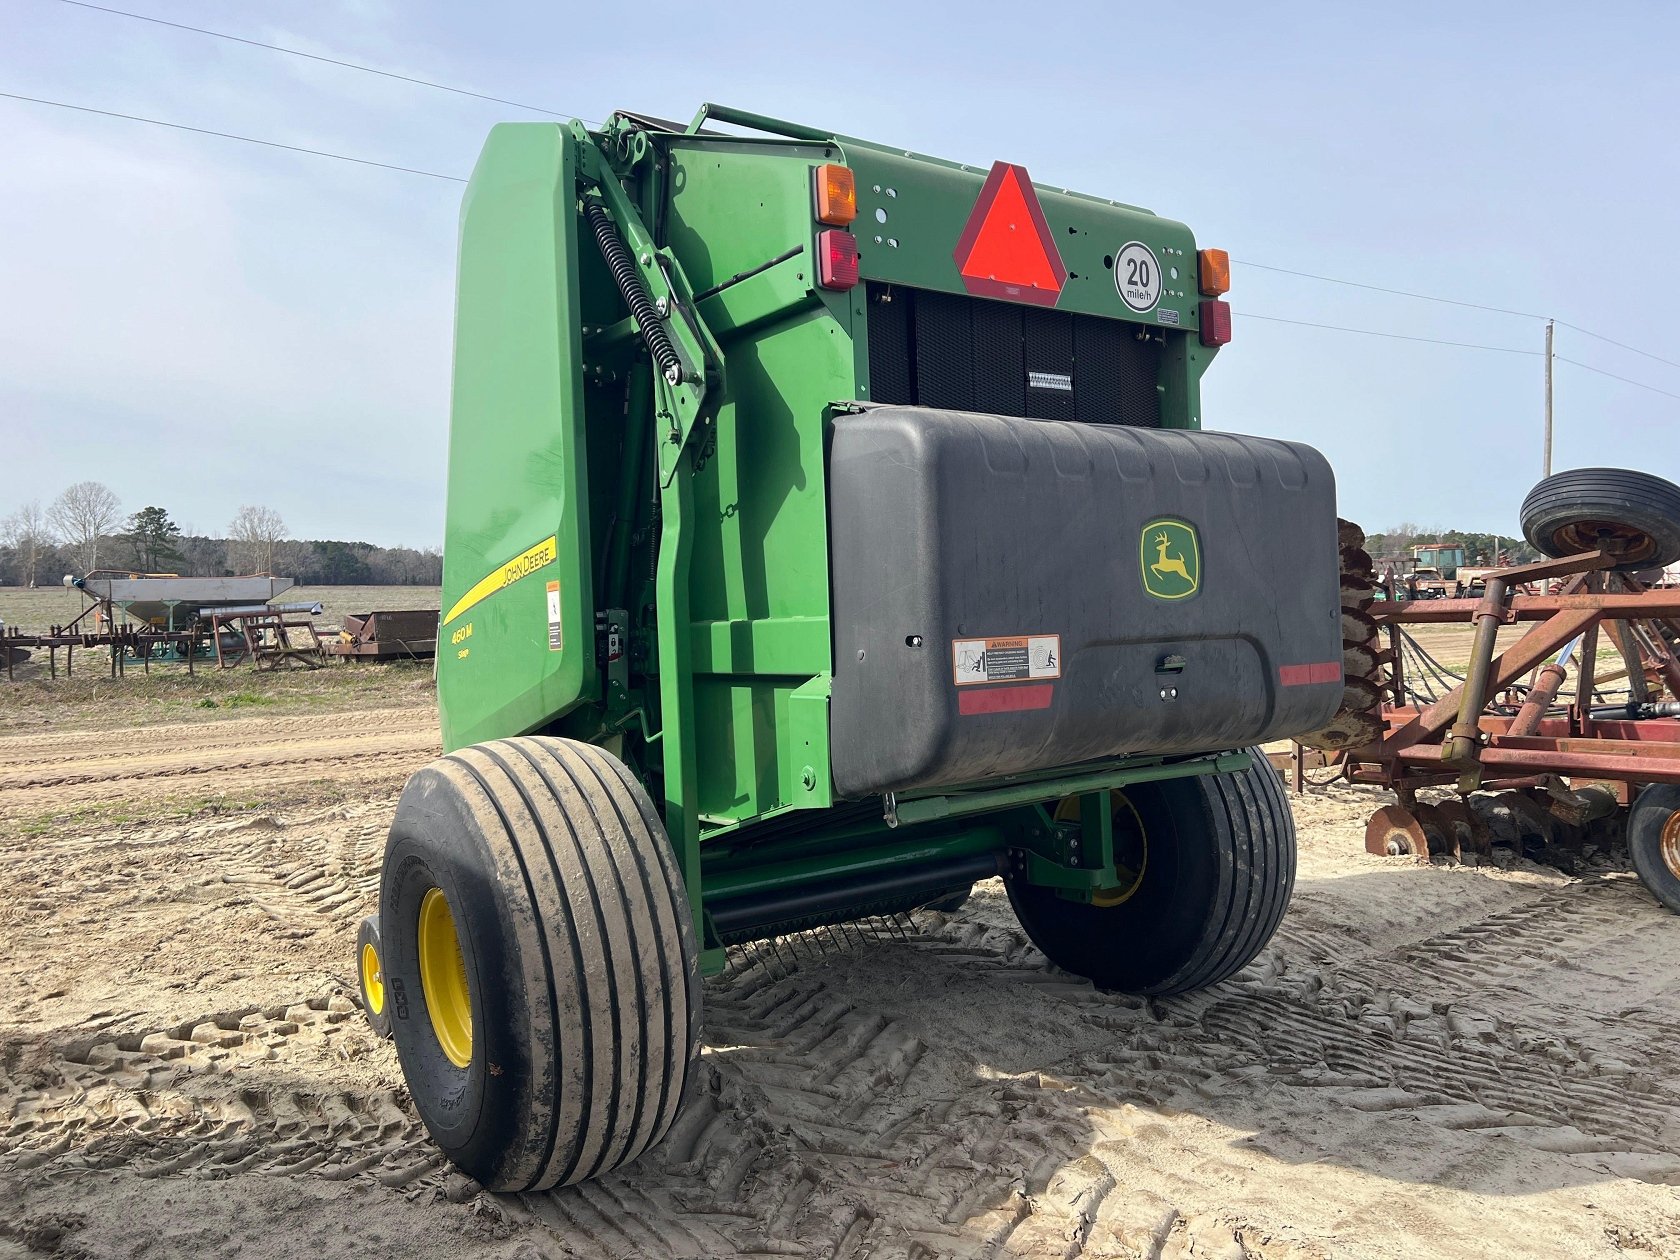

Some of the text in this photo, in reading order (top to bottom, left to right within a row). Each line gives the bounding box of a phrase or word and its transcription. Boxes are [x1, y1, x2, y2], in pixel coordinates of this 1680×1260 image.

[1127, 258, 1150, 288] 20
[1127, 289, 1152, 301] mile/h
[503, 547, 550, 586] JOHN DEERE
[451, 622, 473, 645] 460 M
[997, 640, 1023, 648] WARNING
